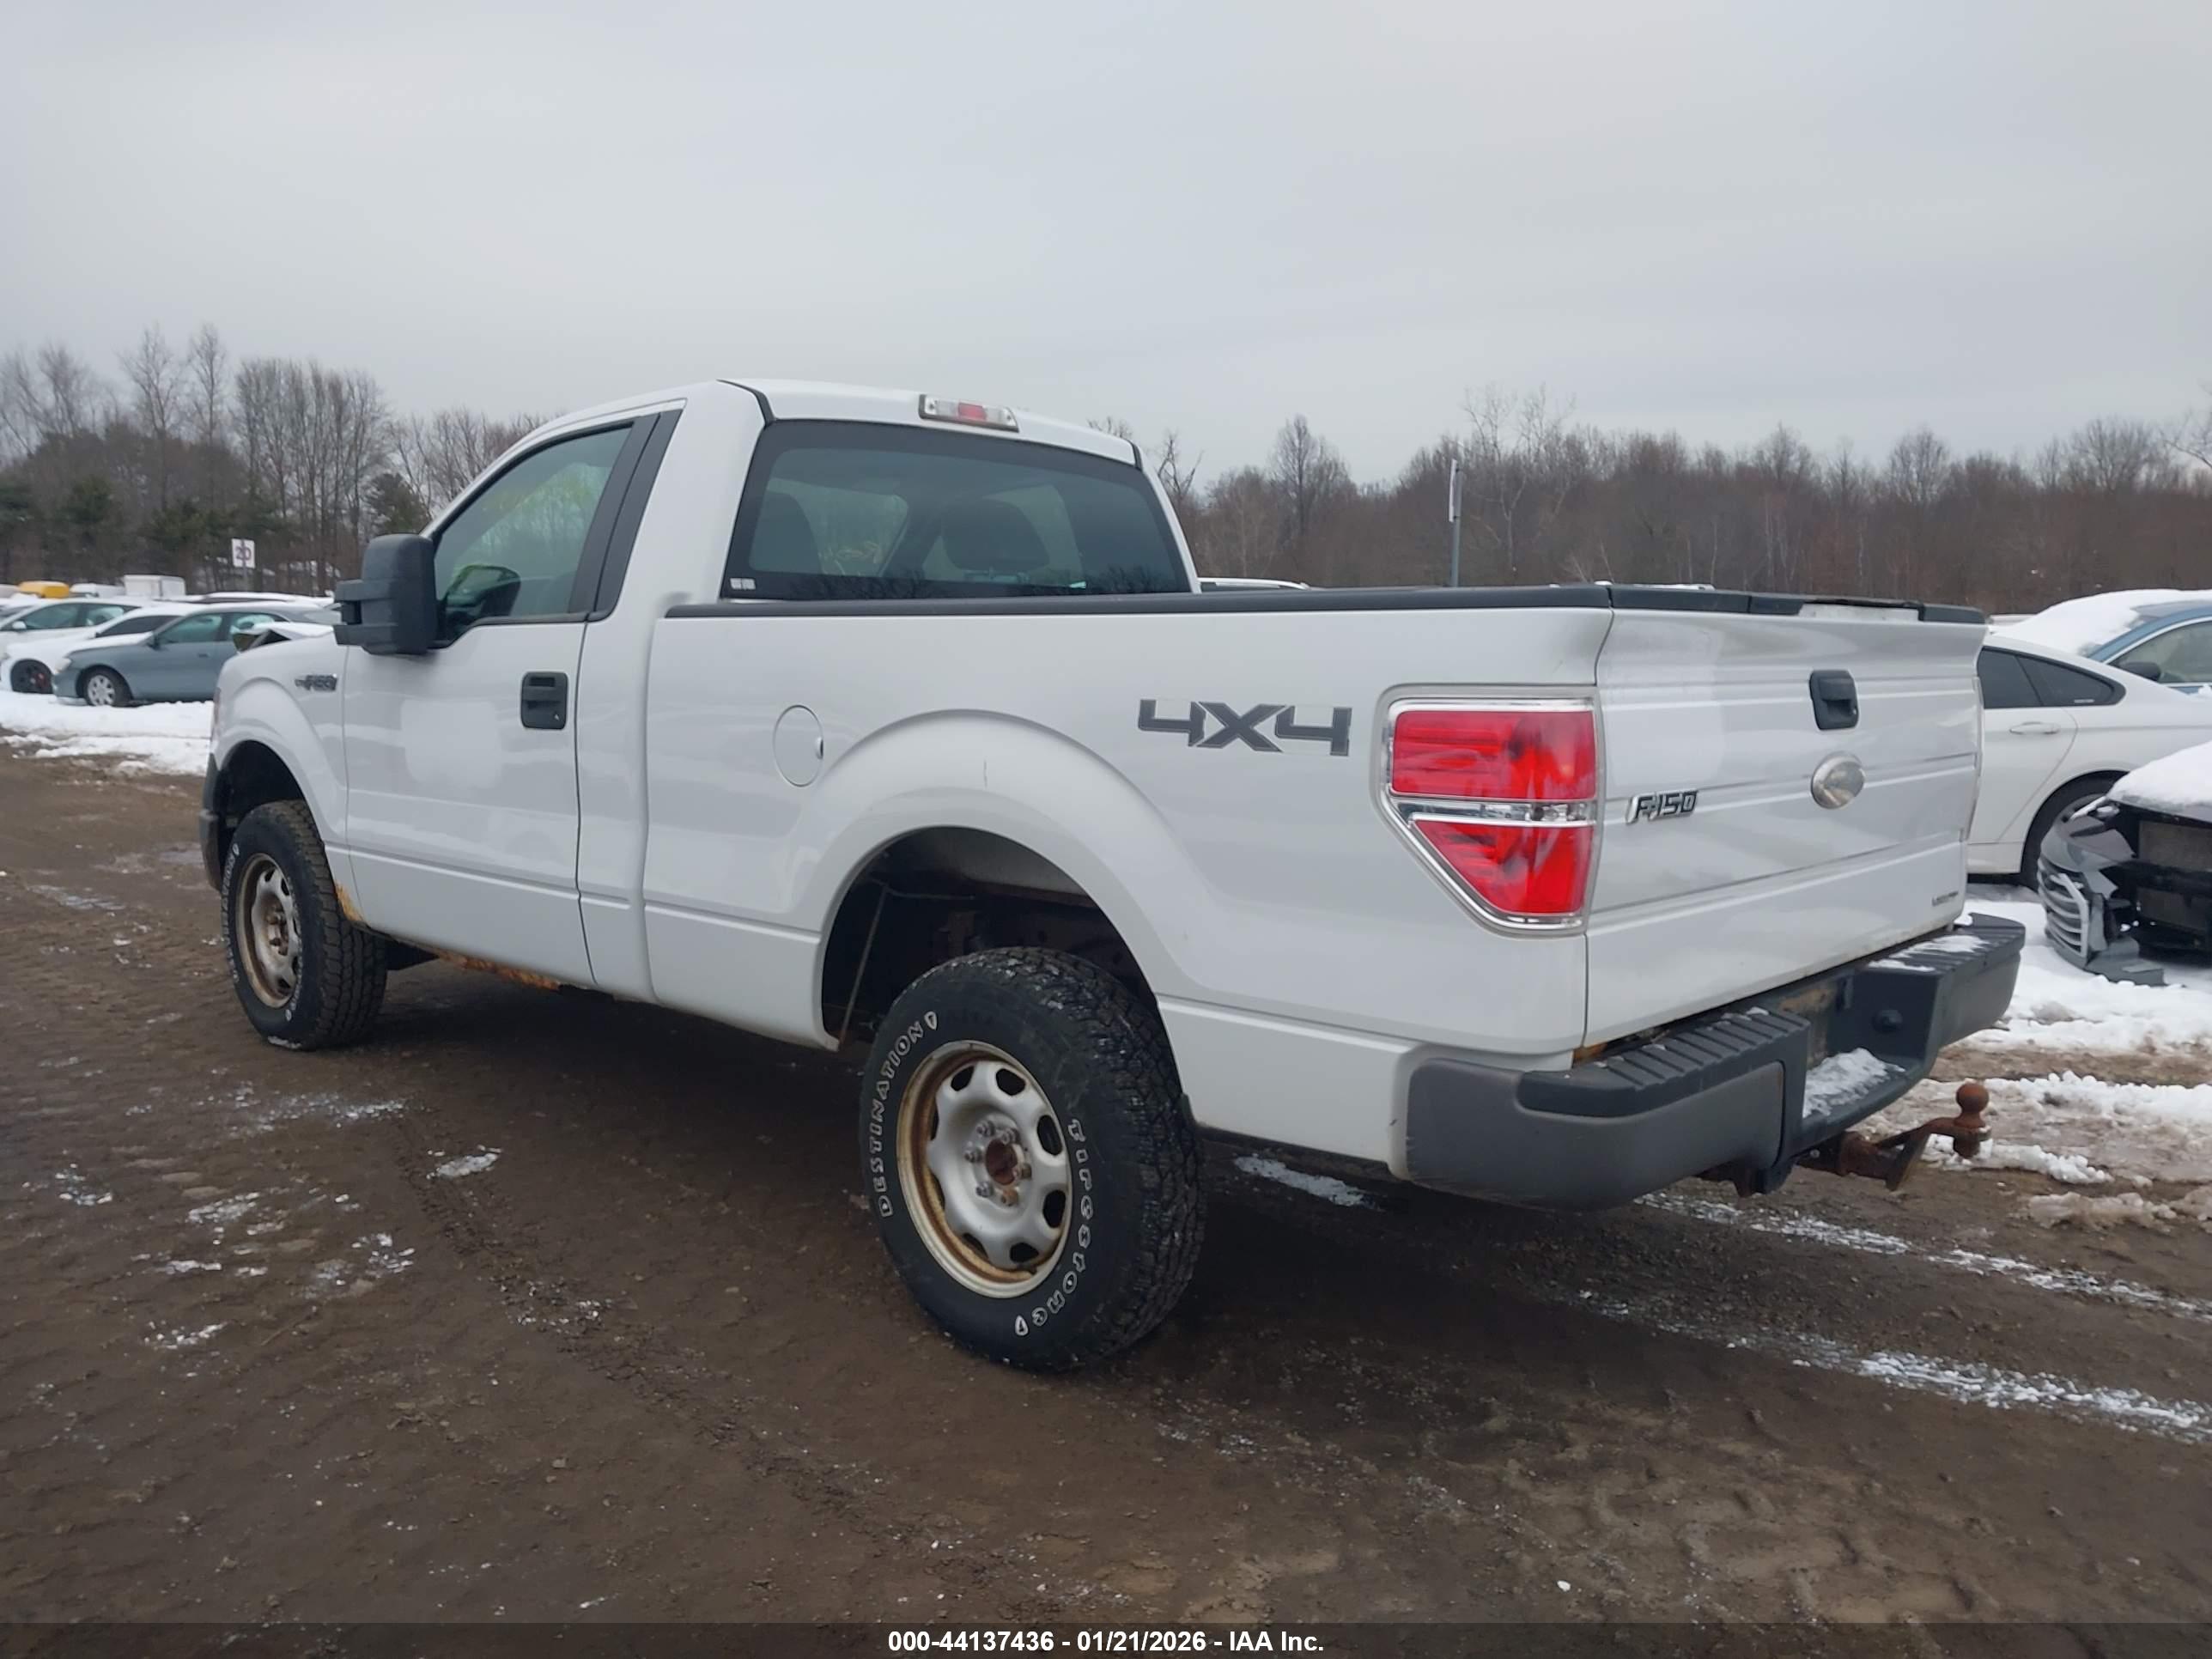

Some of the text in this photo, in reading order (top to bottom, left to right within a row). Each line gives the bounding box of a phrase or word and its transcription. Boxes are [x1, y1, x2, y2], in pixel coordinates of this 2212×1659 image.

[234, 545, 252, 561] 20
[1137, 698, 1353, 757] 4X4
[868, 1020, 924, 1218] DESTINATION
